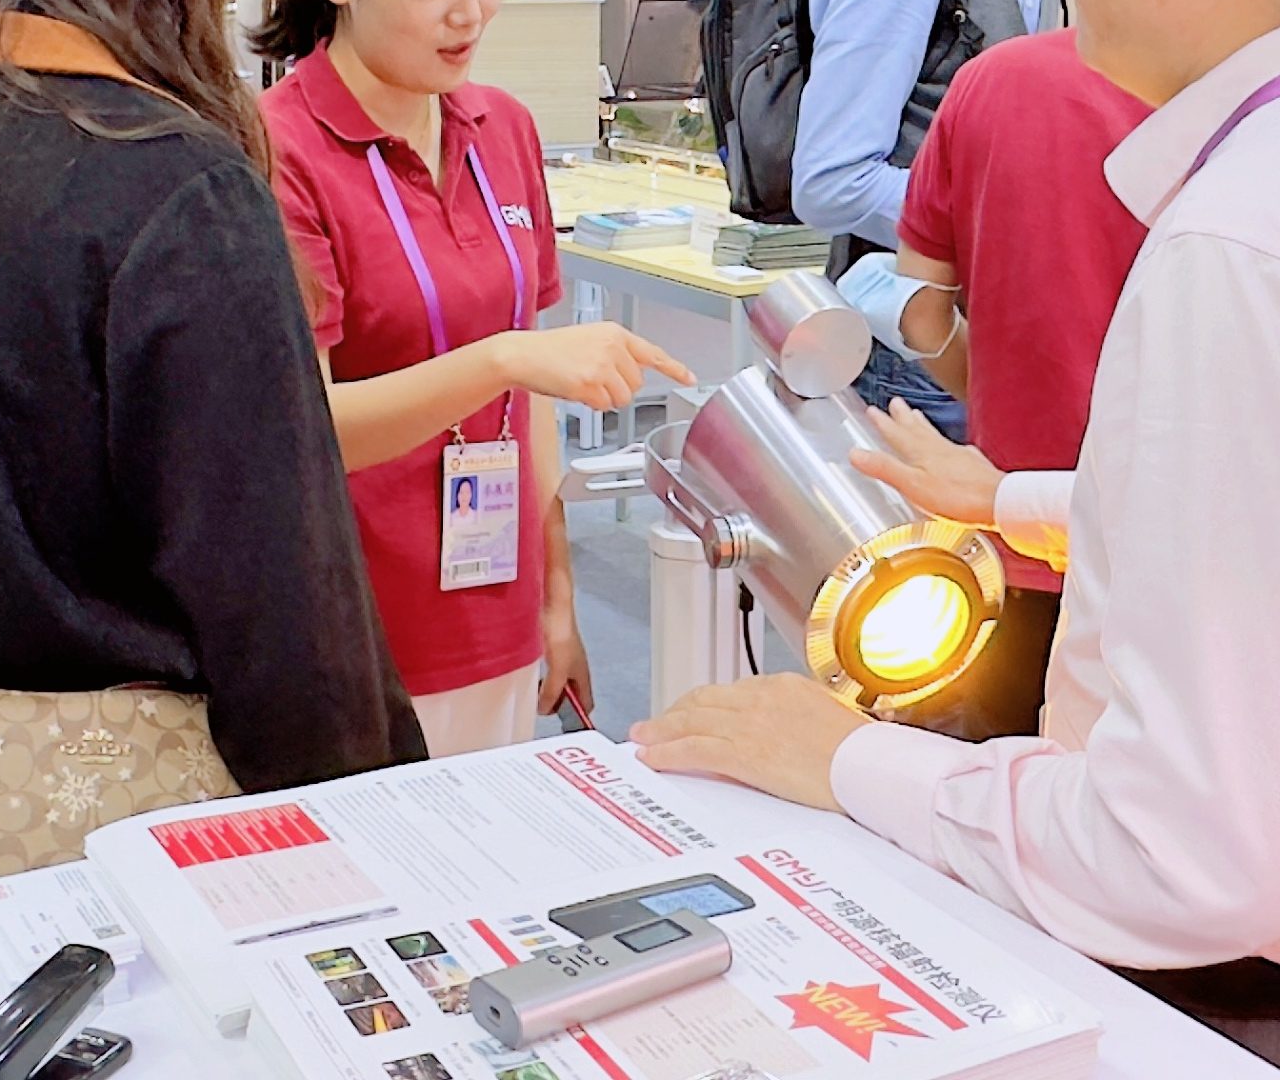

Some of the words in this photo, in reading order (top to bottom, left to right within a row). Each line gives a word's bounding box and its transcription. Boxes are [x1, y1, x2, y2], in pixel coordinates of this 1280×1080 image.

[555, 747, 622, 784] GMY
[763, 849, 827, 887] GMY
[799, 984, 888, 1035] NEW!
